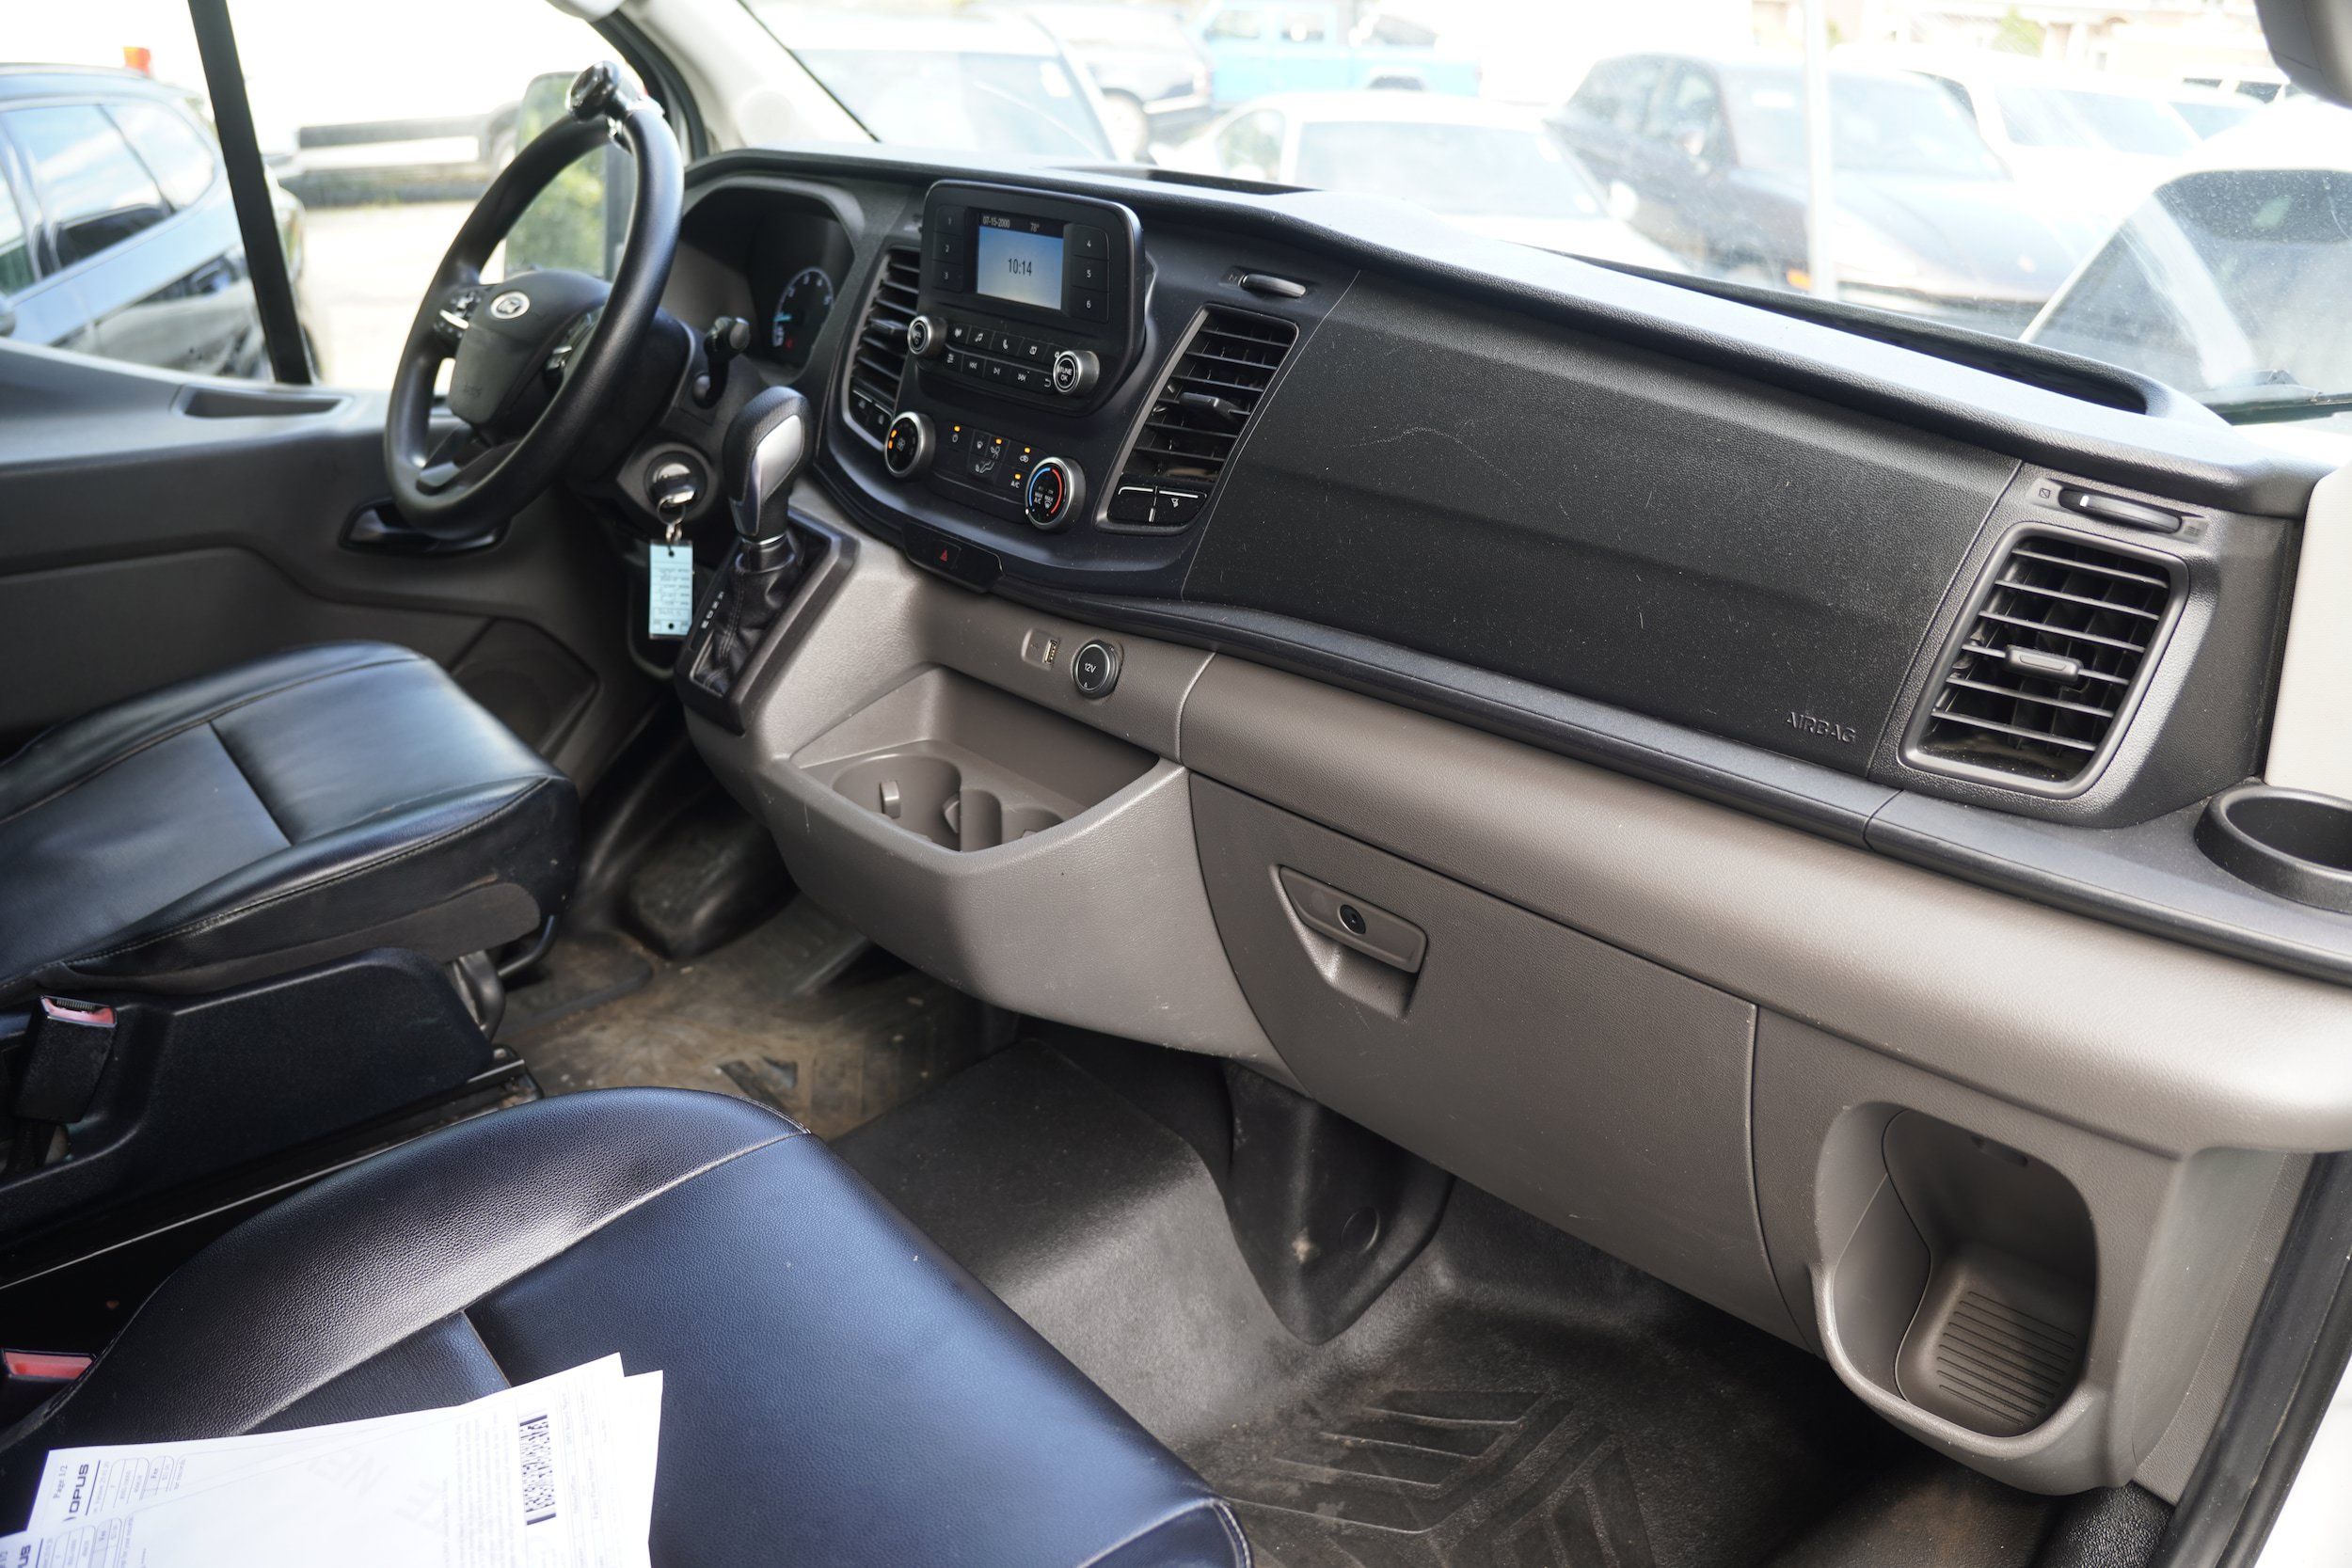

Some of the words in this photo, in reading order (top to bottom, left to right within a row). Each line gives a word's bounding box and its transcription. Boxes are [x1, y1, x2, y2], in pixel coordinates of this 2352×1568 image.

[982, 215, 1010, 229] 07-15-2000
[1086, 239, 1092, 248] 4
[1008, 258, 1032, 277] 10:14
[1086, 268, 1092, 279] 5
[1085, 299, 1092, 309] 6
[1060, 373, 1069, 382] OK
[1010, 480, 1021, 489] A/C
[1084, 662, 1096, 673] 12V
[1787, 711, 1856, 743] AIRBAG
[69, 1464, 89, 1513] OPUS
